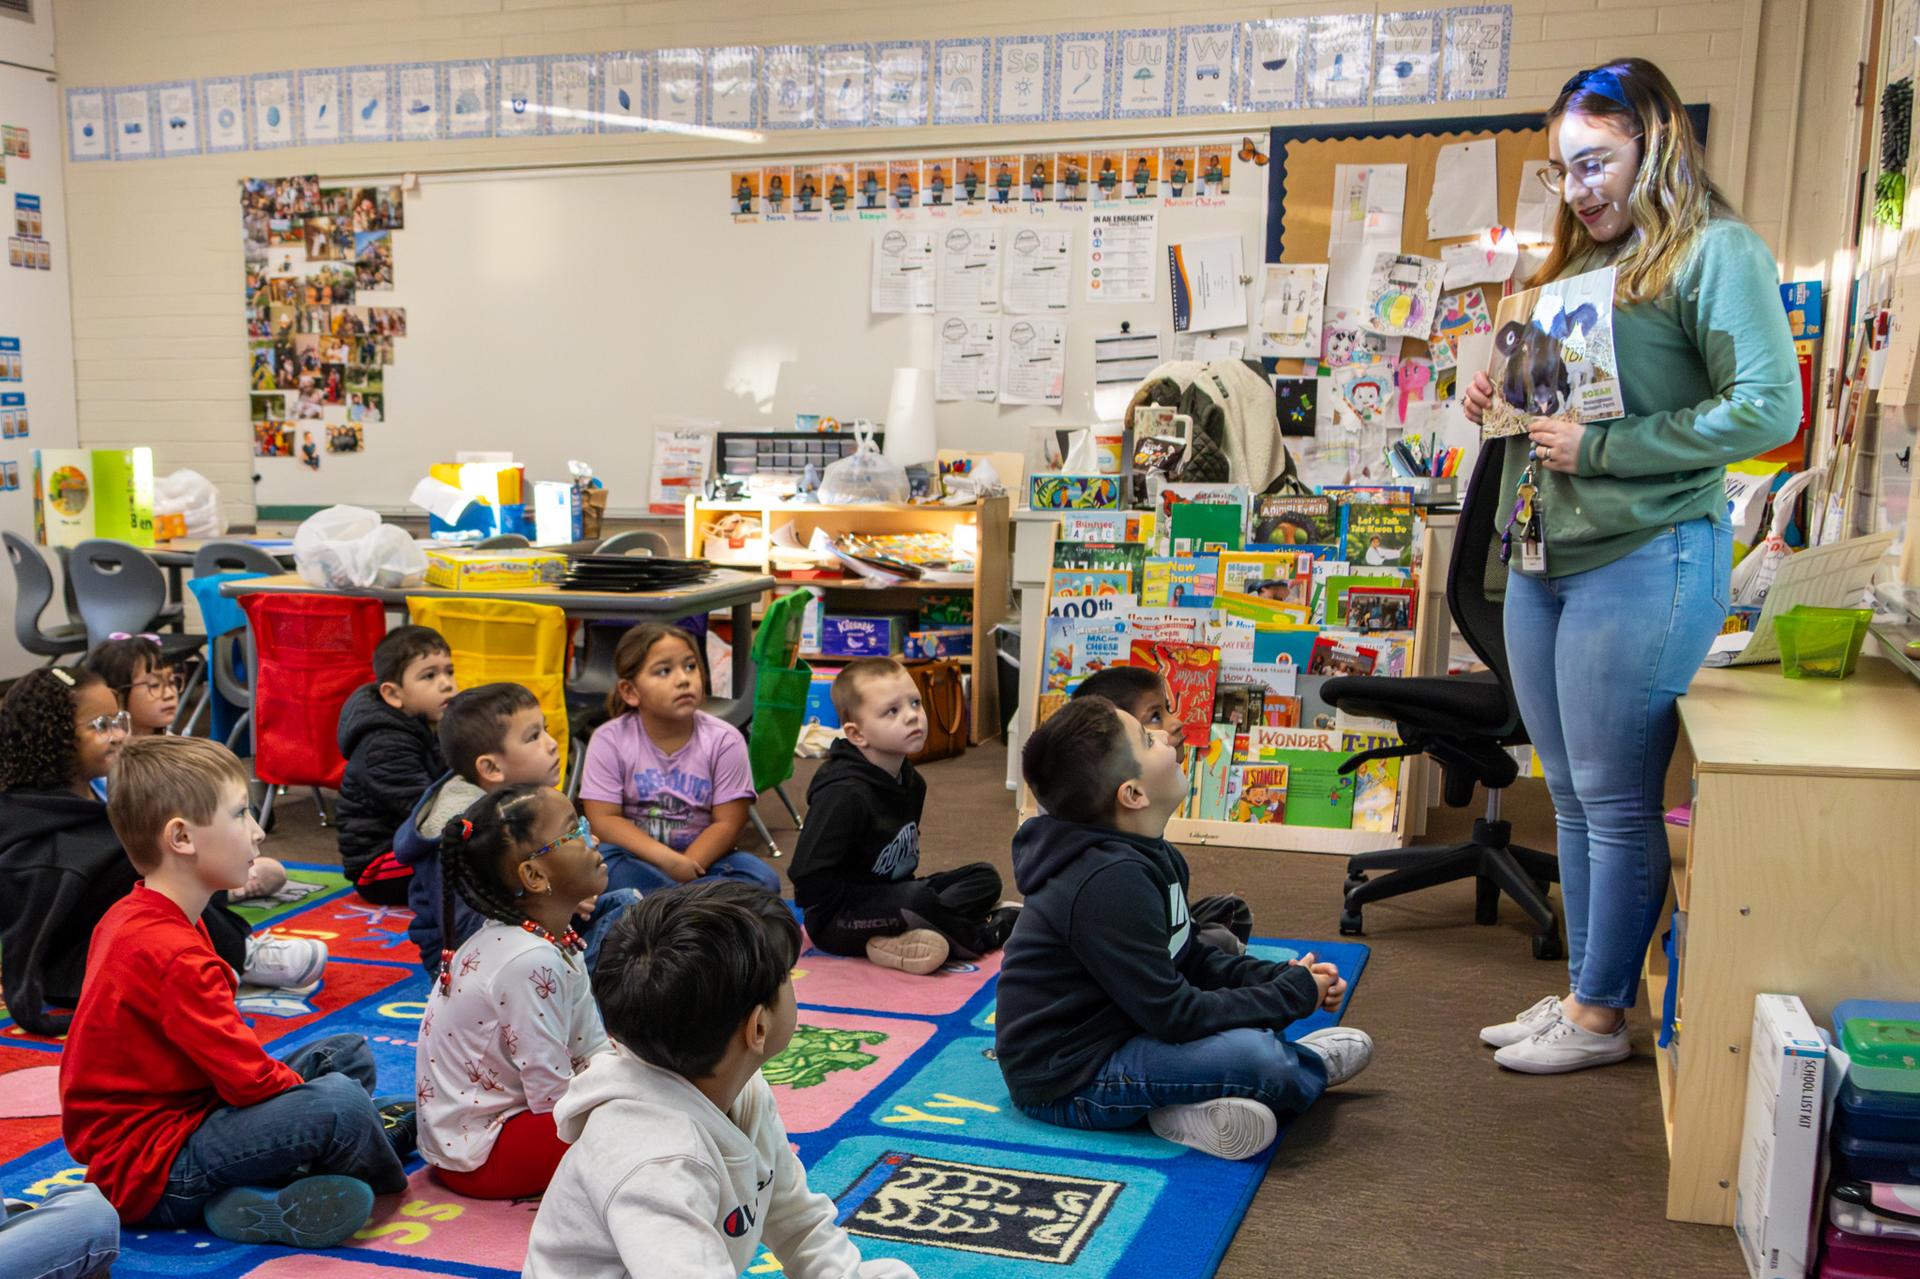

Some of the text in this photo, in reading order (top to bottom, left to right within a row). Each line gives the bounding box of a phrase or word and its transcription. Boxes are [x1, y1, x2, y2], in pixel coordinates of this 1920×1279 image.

[1456, 18, 1500, 49] Zz
[1067, 45, 1099, 70] Tt
[1126, 42, 1162, 66] Uu
[1192, 36, 1229, 61] Vv
[1007, 49, 1039, 73] Ss
[1093, 214, 1154, 224] IN AN EMERGENCY
[1358, 516, 1399, 524] Let's Talk
[1394, 525, 1407, 533] Do
[837, 619, 876, 634] Kleenex
[1086, 643, 1119, 651] CHEESE
[1258, 729, 1333, 752] WONDER
[1251, 767, 1285, 786] STANLEY
[1798, 1059, 1817, 1129] SCHOOL LIST KIT
[882, 1092, 1000, 1126] Yy
